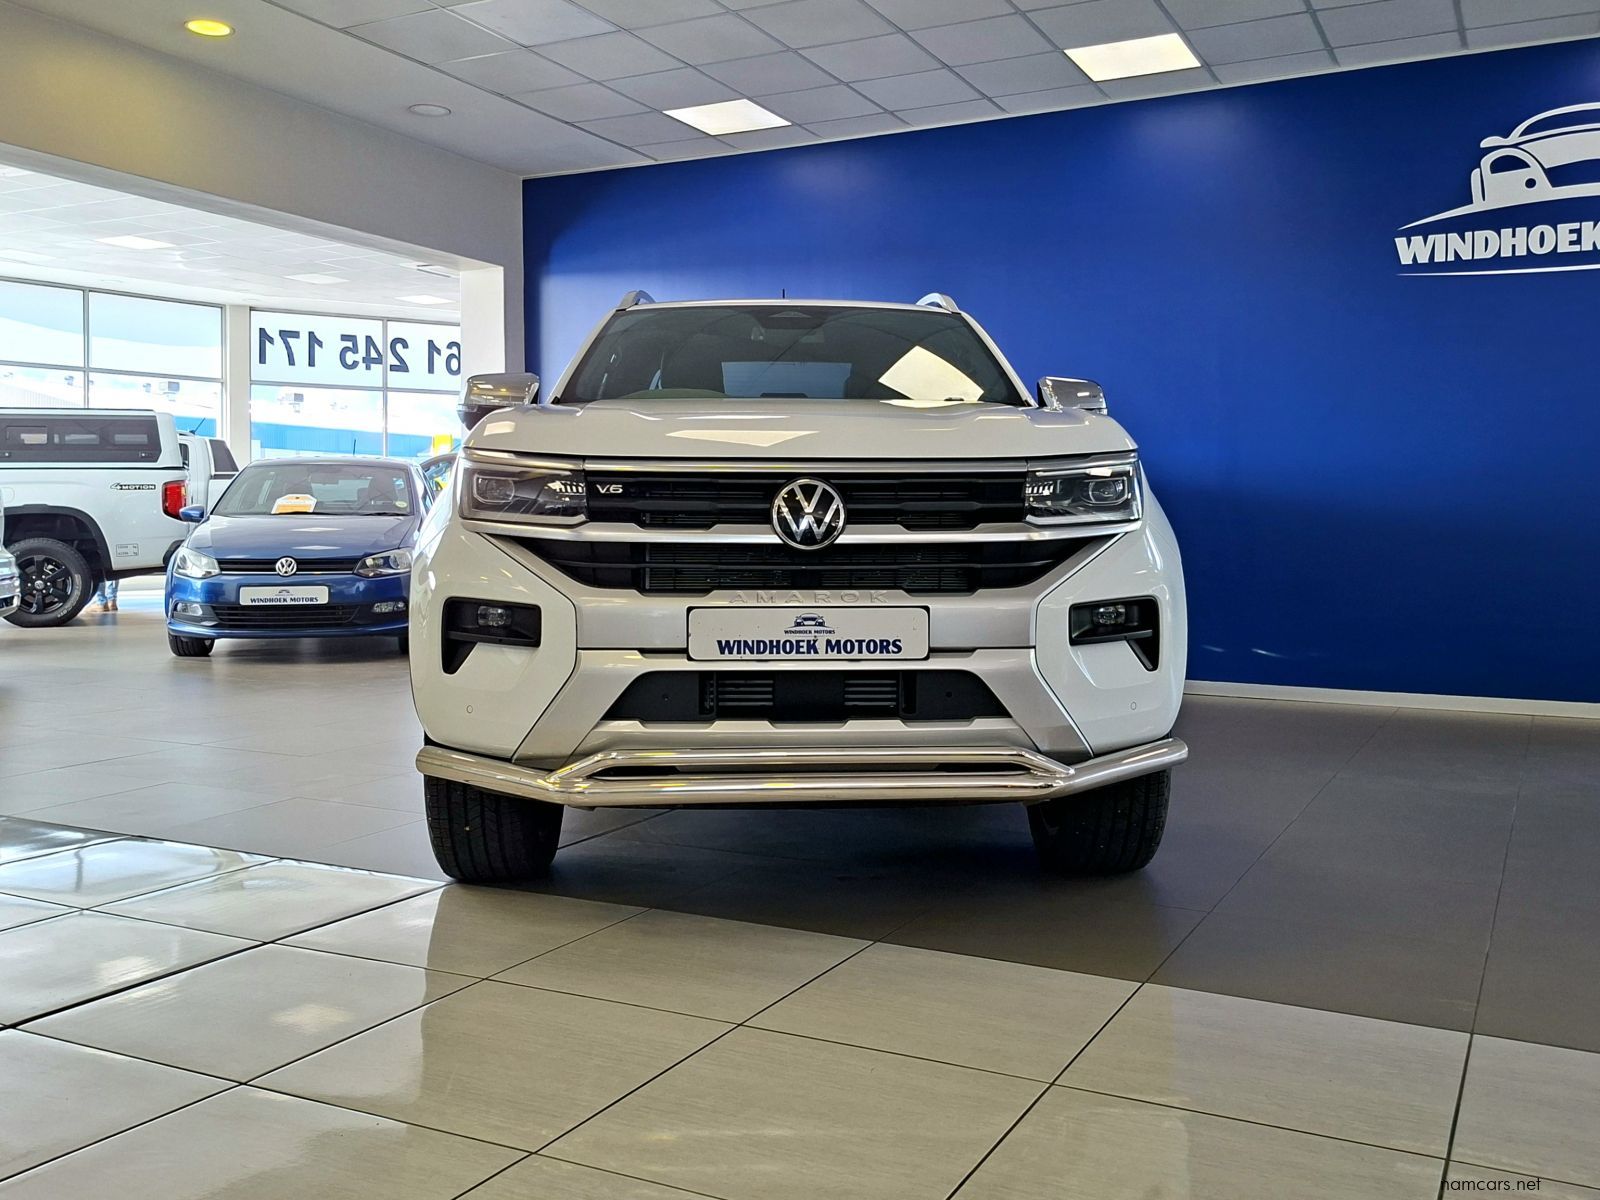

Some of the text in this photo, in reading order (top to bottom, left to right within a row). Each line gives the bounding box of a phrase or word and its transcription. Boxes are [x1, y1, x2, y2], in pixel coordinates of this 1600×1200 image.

[1394, 221, 1600, 265] WINDHOEK
[110, 482, 156, 491] 4MOTION
[596, 484, 623, 494] V6
[728, 590, 888, 604] AMAROK
[716, 639, 902, 655] WINDHOEK MOTORS
